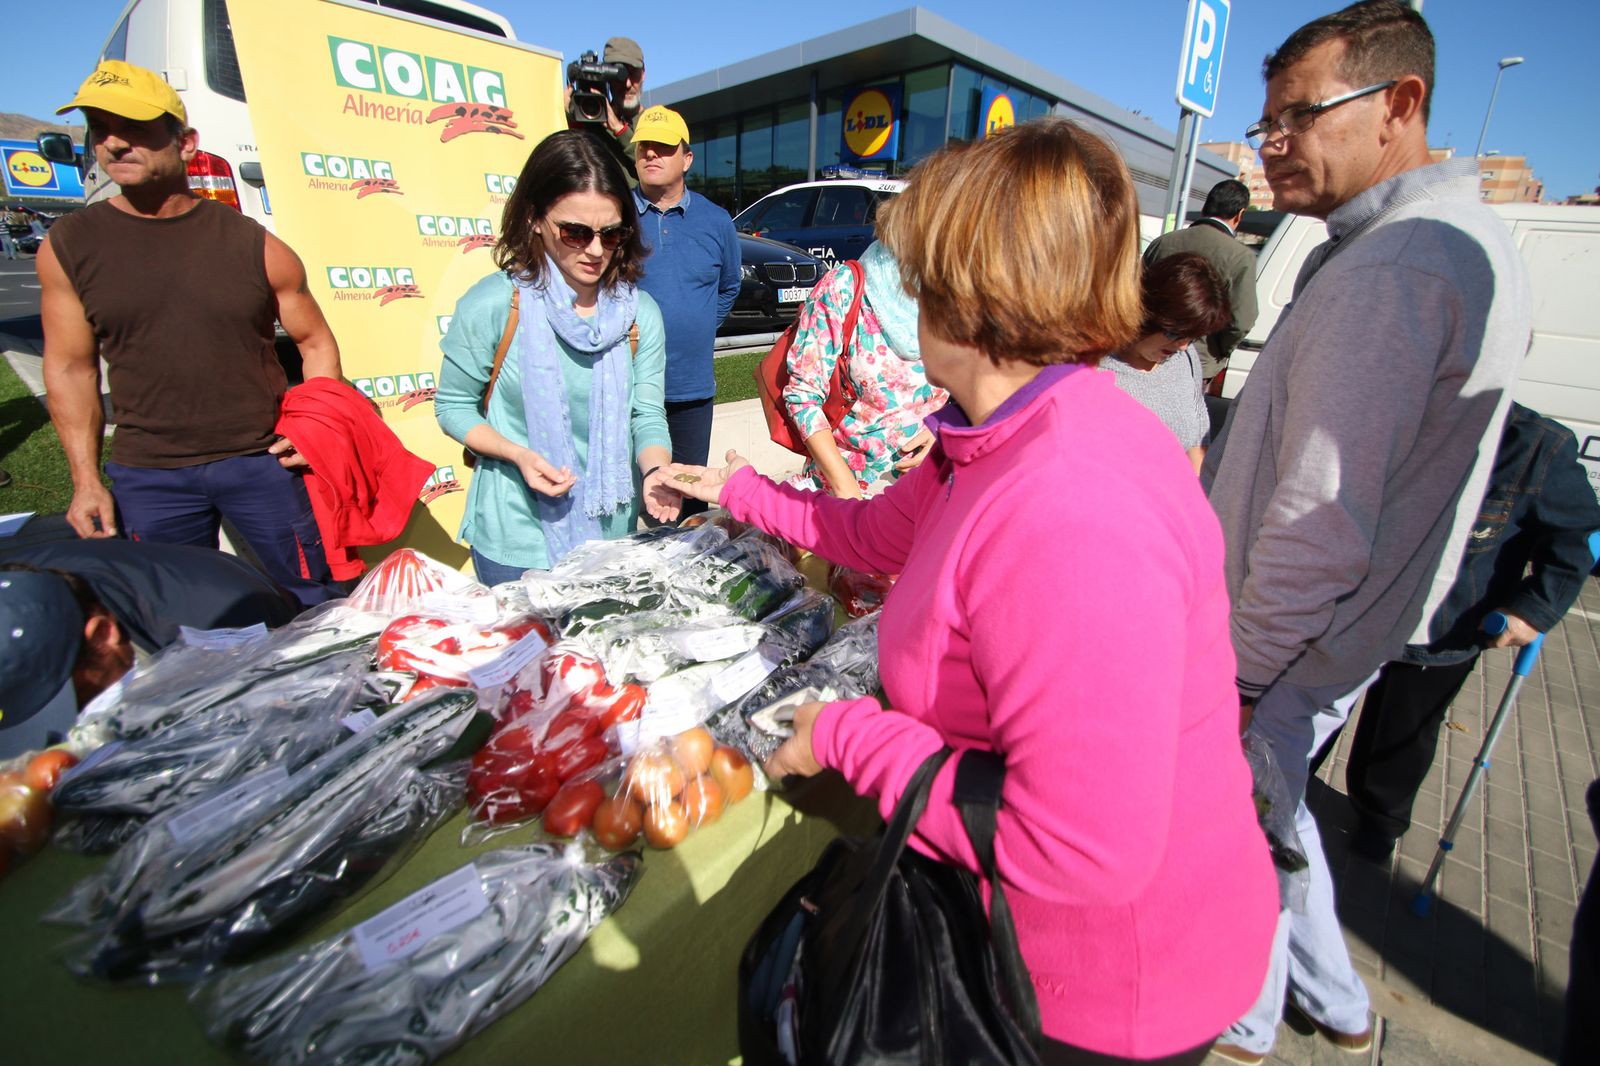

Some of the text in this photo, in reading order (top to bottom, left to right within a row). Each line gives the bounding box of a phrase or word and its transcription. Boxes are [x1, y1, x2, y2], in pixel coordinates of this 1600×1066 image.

[1188, 1, 1216, 85] P
[333, 39, 506, 108] COAG
[342, 94, 423, 125] Almería
[303, 153, 393, 180] COAG
[485, 174, 518, 194] CO
[417, 215, 493, 235] COAG
[328, 267, 415, 288] COAG
[784, 289, 802, 300] 0037
[354, 372, 435, 398] COAG
